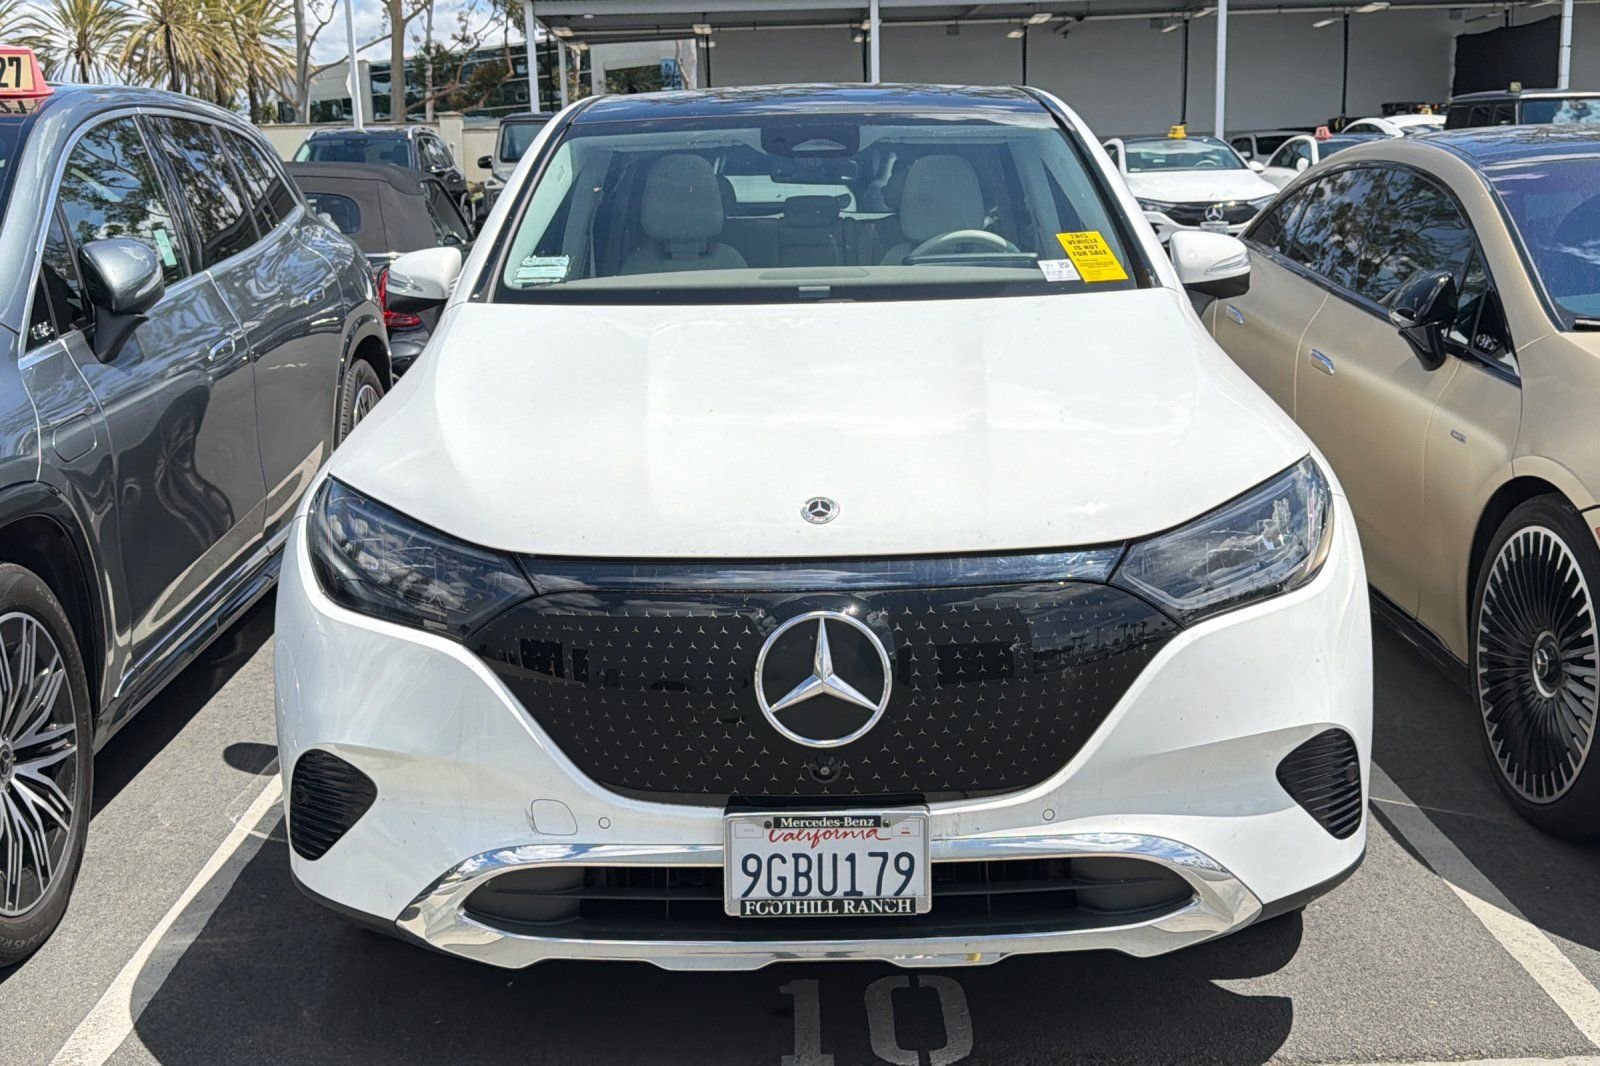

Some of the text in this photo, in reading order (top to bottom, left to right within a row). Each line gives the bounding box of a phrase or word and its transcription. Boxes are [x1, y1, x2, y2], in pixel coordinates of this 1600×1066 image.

[780, 817, 875, 828] Mercedes-Benz
[768, 828, 892, 849] California
[741, 851, 915, 898] 9GBU179
[744, 898, 912, 915] FOOTHILL RANCH
[779, 974, 974, 1066] 10
